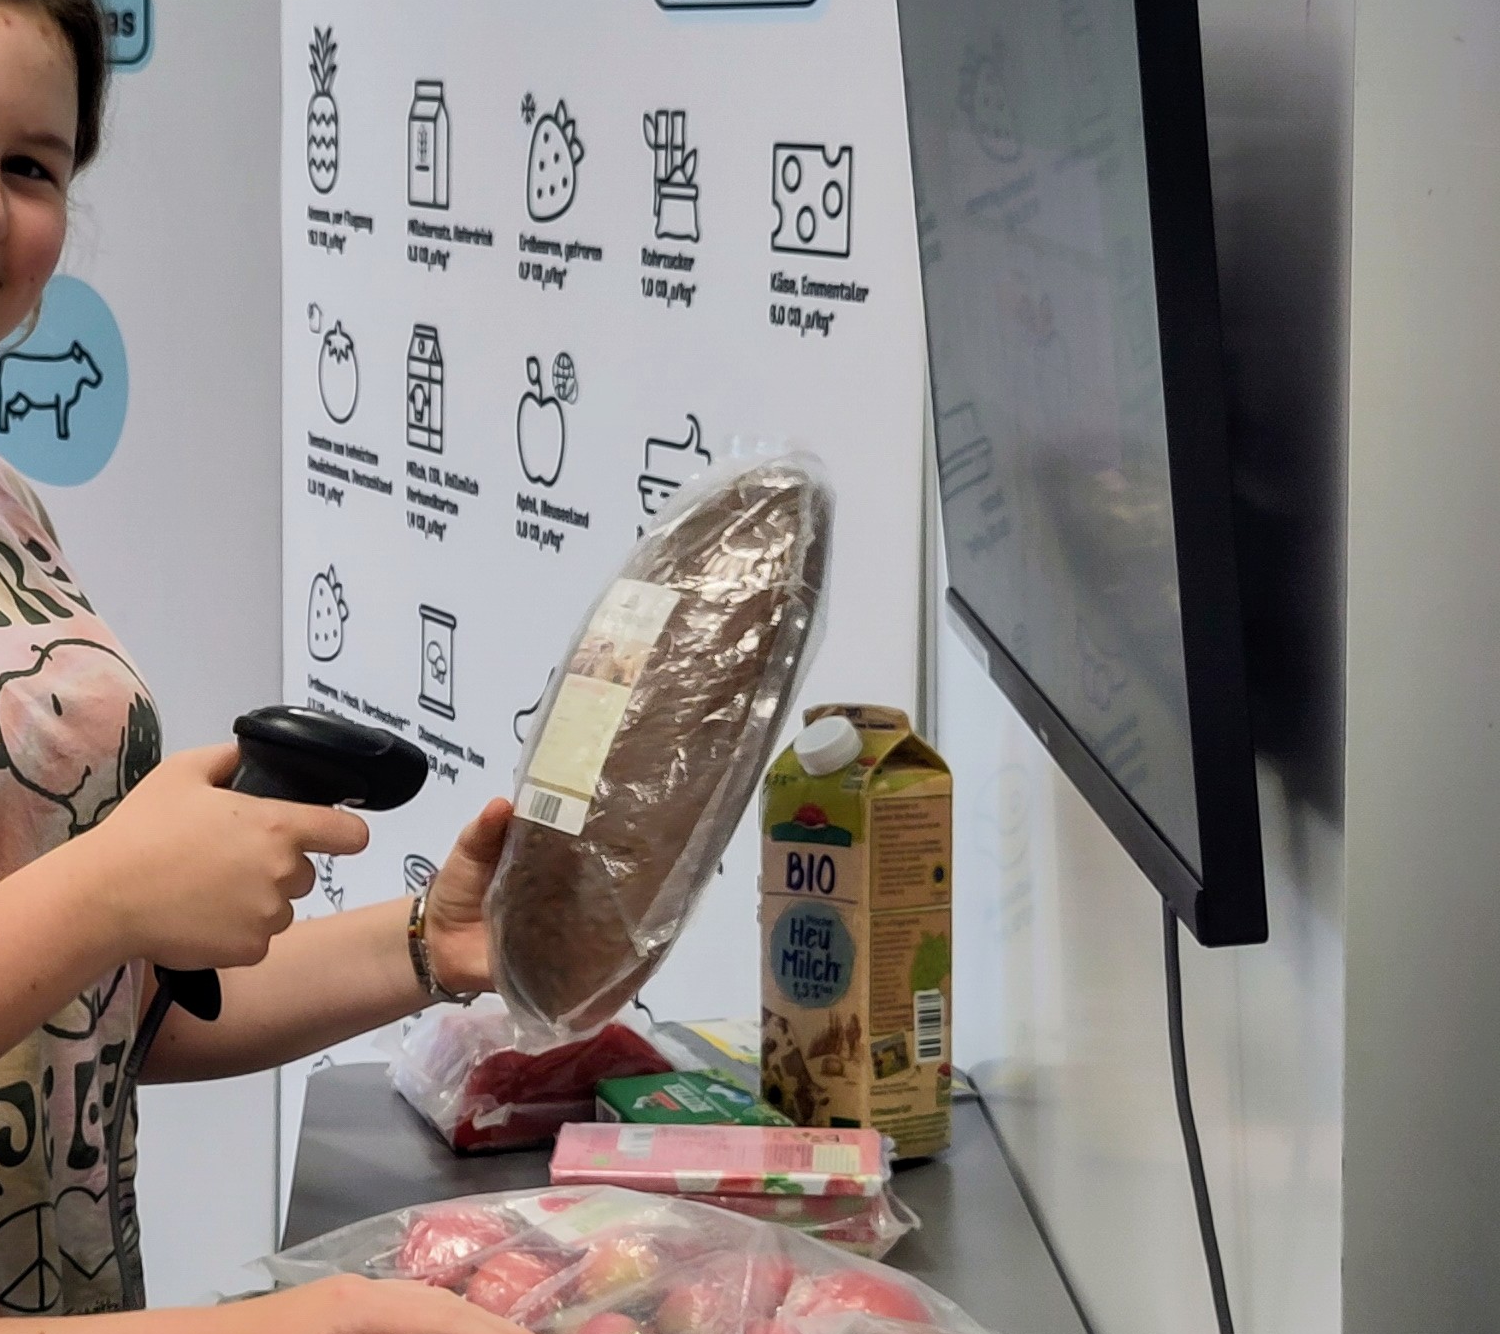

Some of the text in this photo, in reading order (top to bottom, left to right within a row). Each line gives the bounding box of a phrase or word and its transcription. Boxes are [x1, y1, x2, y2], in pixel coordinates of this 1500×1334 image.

[801, 275, 870, 303] Emmentaler
[786, 851, 836, 895] BIO
[789, 918, 831, 951] Heu
[781, 948, 841, 984] Milch
